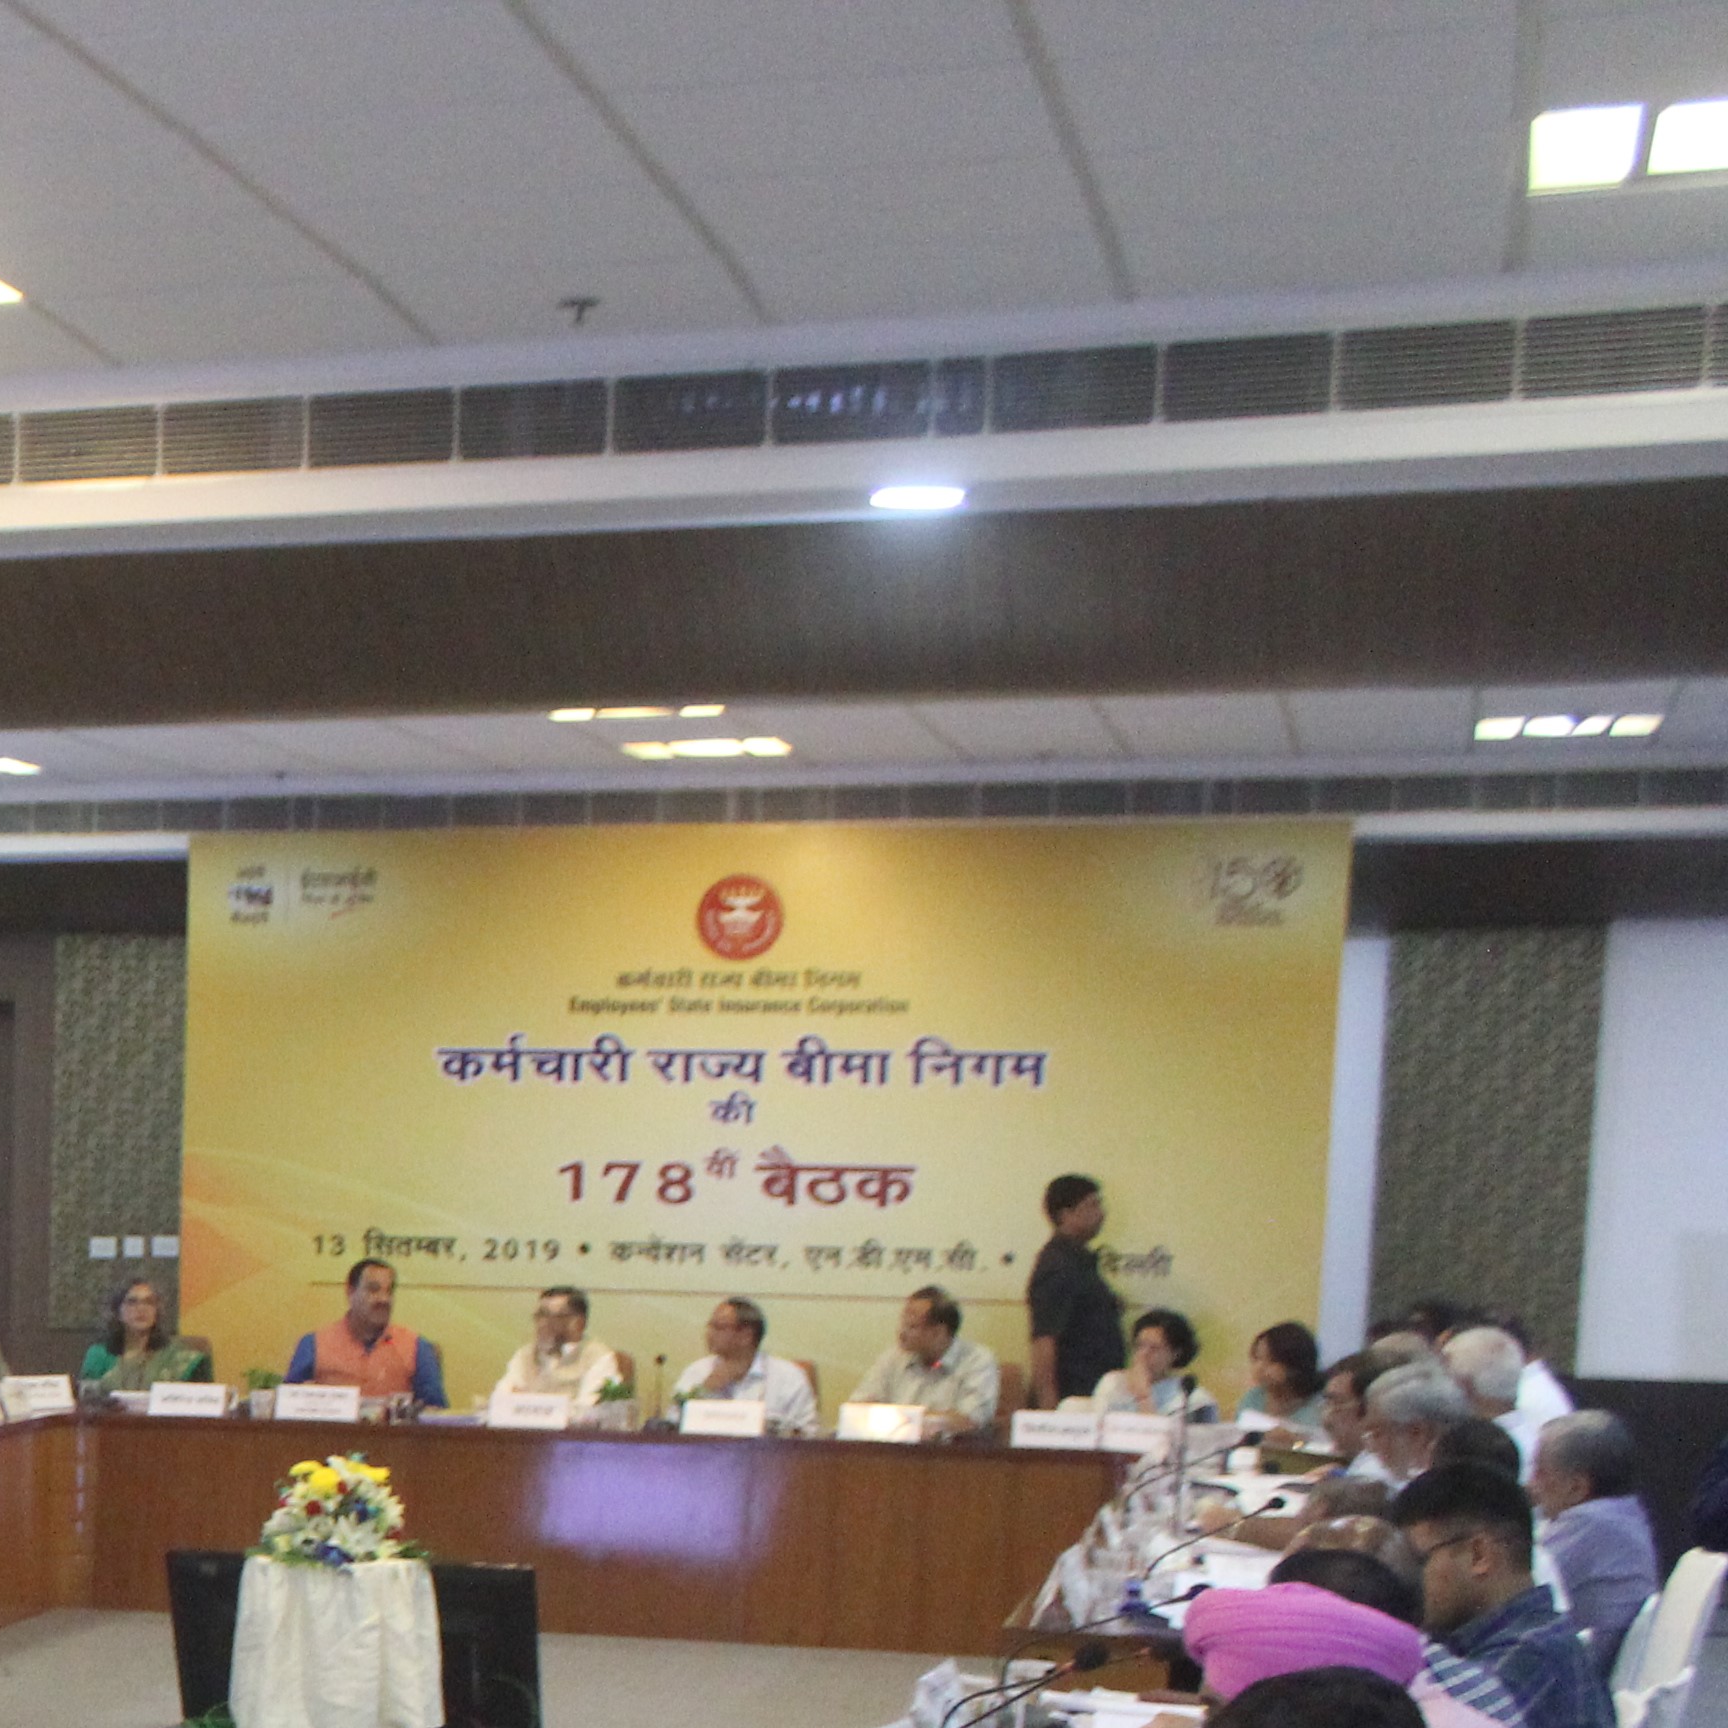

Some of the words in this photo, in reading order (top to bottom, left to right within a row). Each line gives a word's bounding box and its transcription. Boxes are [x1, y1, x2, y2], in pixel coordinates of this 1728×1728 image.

[438, 1033, 635, 1085] कर्मचारी
[646, 1045, 766, 1085] राज्य
[780, 1033, 891, 1086] बीमा
[908, 1035, 1048, 1088] निगम
[709, 1089, 756, 1125] की
[754, 1144, 917, 1208] बैठक
[313, 1233, 345, 1256] 13
[482, 1237, 561, 1261] 2019
